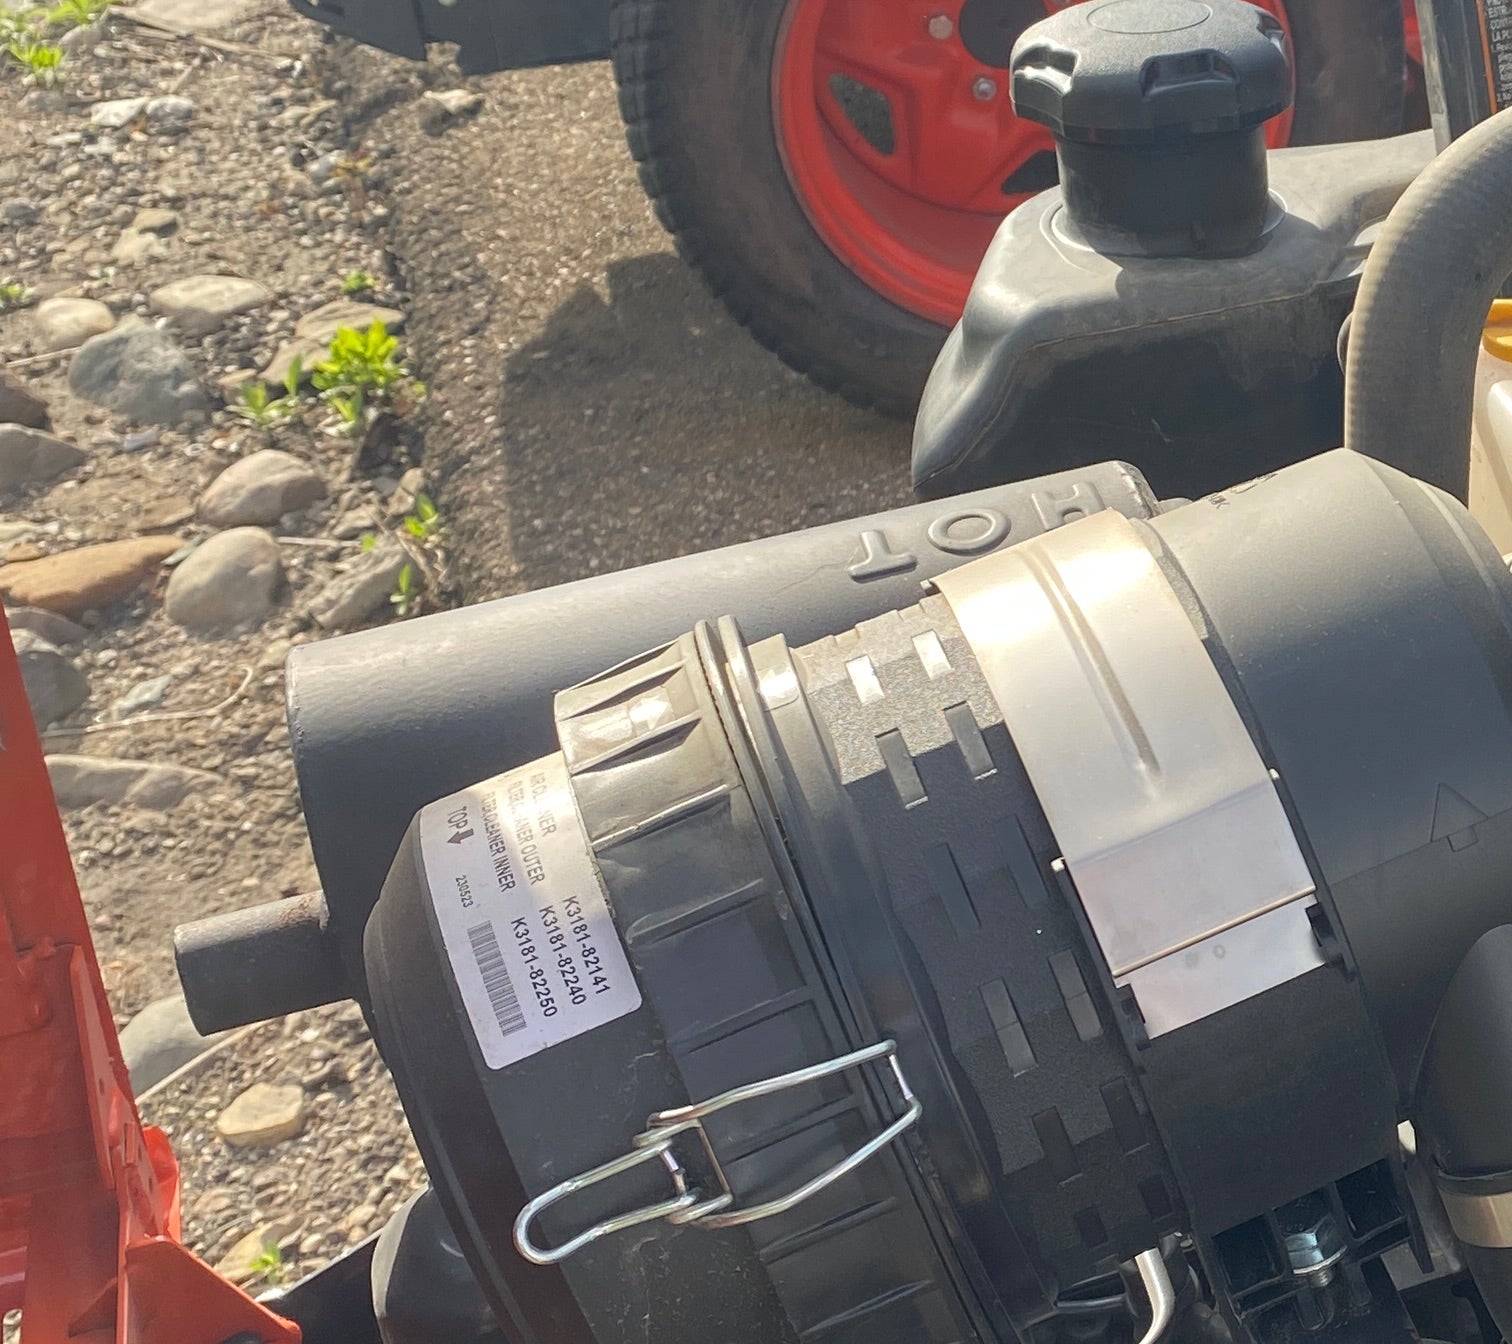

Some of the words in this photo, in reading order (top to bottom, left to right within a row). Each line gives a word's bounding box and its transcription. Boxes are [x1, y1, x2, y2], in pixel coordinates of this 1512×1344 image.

[846, 481, 1107, 585] HOT
[448, 805, 468, 830] TOP
[493, 855, 516, 893] INNER
[509, 915, 558, 1020] K3181-82250
[520, 845, 545, 885] OUTER
[538, 903, 588, 1008] K3181-82240
[561, 893, 611, 997] K3181-82141
